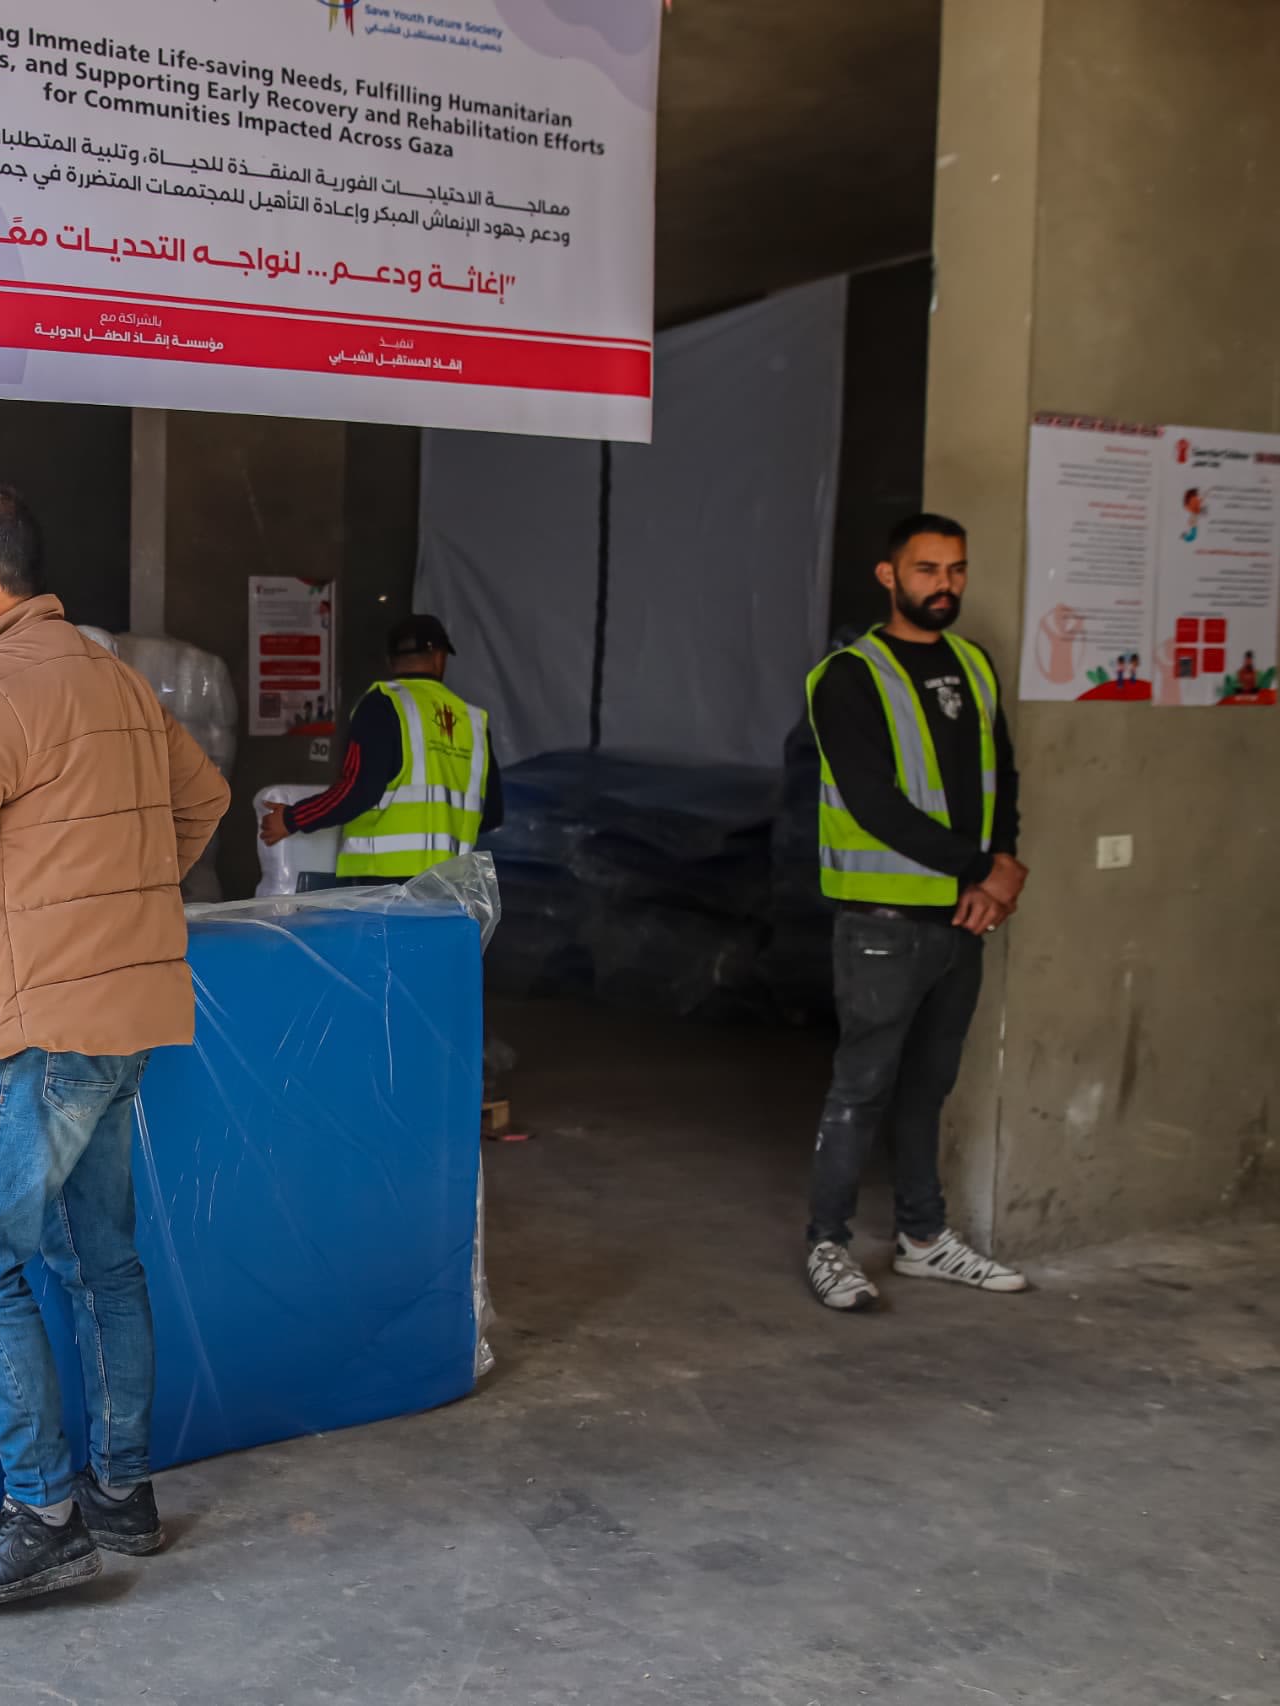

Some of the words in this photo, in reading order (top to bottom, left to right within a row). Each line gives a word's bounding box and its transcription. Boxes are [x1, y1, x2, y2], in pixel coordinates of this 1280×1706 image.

[365, 5, 390, 17] Save
[393, 9, 424, 23] Youth
[428, 16, 462, 30] Future
[465, 22, 502, 38] Society
[29, 28, 150, 63] Immediate
[158, 48, 273, 86] Life-saving
[281, 67, 348, 96] Needs,
[356, 79, 441, 111] Fulfilling
[449, 94, 572, 128] Humanitarian
[25, 56, 68, 76] and
[75, 62, 200, 101] Supporting
[207, 83, 259, 109] Early
[267, 92, 358, 124] Recovery
[365, 107, 401, 126] and
[407, 113, 538, 146] Rehabilitation
[544, 133, 605, 156] Efforts
[43, 83, 77, 105] for
[84, 90, 230, 126] Communities
[237, 112, 332, 142] Impacted
[339, 127, 403, 151] Across
[408, 138, 454, 158] Gaza
[81, 137, 139, 163] وتلبية
[34, 159, 61, 190] في
[66, 165, 141, 192] المتضررة
[228, 158, 311, 183] المنقذة
[315, 169, 377, 193] الفورية
[146, 178, 244, 205] للمجتمعات
[249, 189, 309, 212] التأهيل
[382, 176, 481, 207] الاحتياجات
[486, 189, 570, 217] معالجة
[313, 197, 369, 224] وإعادة
[373, 207, 419, 225] المبكر
[423, 209, 480, 236] الإنعاش
[484, 218, 526, 239] جهود
[530, 224, 570, 246] ودعم
[56, 223, 185, 263] التحديات
[193, 246, 301, 275] لنواجه
[99, 313, 116, 326] مع
[119, 312, 162, 327] بالشراكة
[34, 322, 80, 342] الدولية
[83, 327, 130, 346] الطفل
[133, 330, 169, 350] إنقاذ
[172, 333, 224, 352] مؤسسة
[379, 335, 413, 350] تنفيذ
[329, 349, 373, 367] الشبابي
[376, 354, 431, 371] المستقبل
[433, 357, 462, 374] إنقاذ
